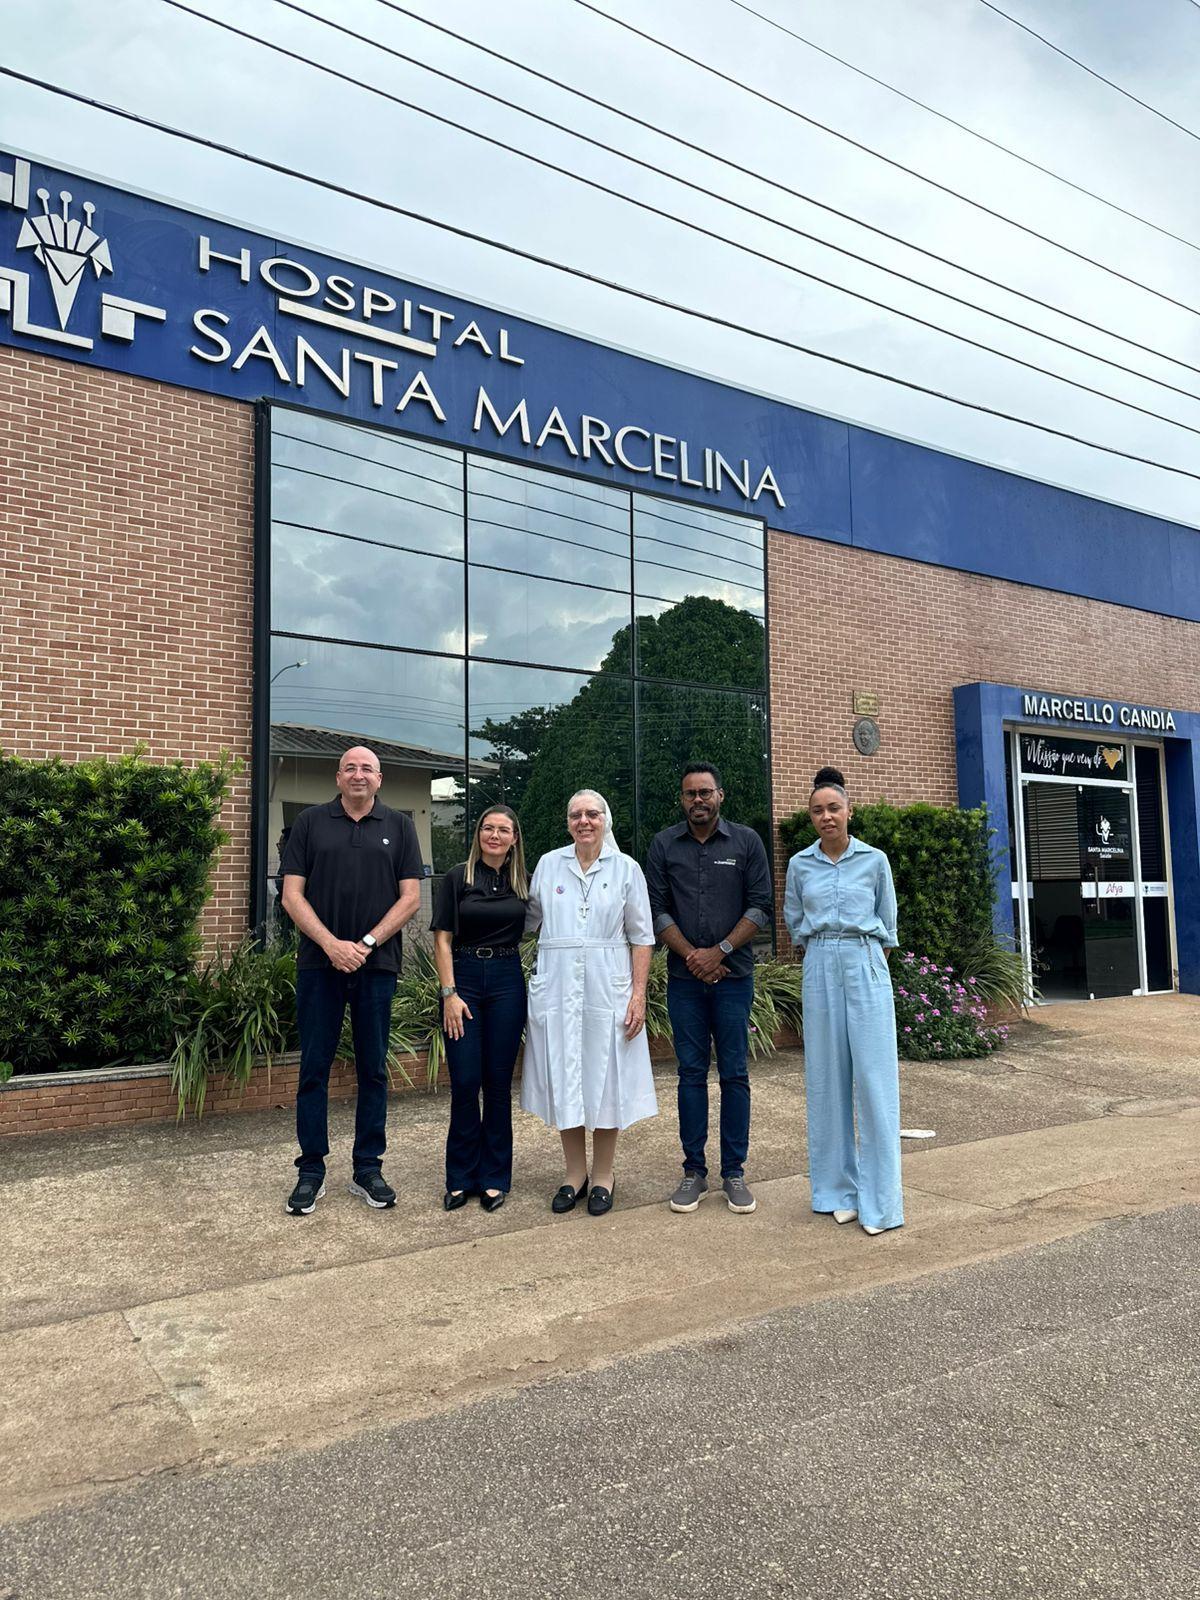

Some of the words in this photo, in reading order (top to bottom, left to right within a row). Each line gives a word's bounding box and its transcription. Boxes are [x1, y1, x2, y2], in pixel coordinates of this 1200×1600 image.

[199, 235, 525, 365] HOSPITAL
[190, 309, 447, 423] SANTA
[472, 385, 786, 508] MARCELINA
[1024, 694, 1114, 724] MARCELLO
[1120, 706, 1176, 731] CANDIA
[1027, 738, 1060, 768] Missão
[1061, 752, 1075, 774] que
[1106, 883, 1124, 896] Afya
